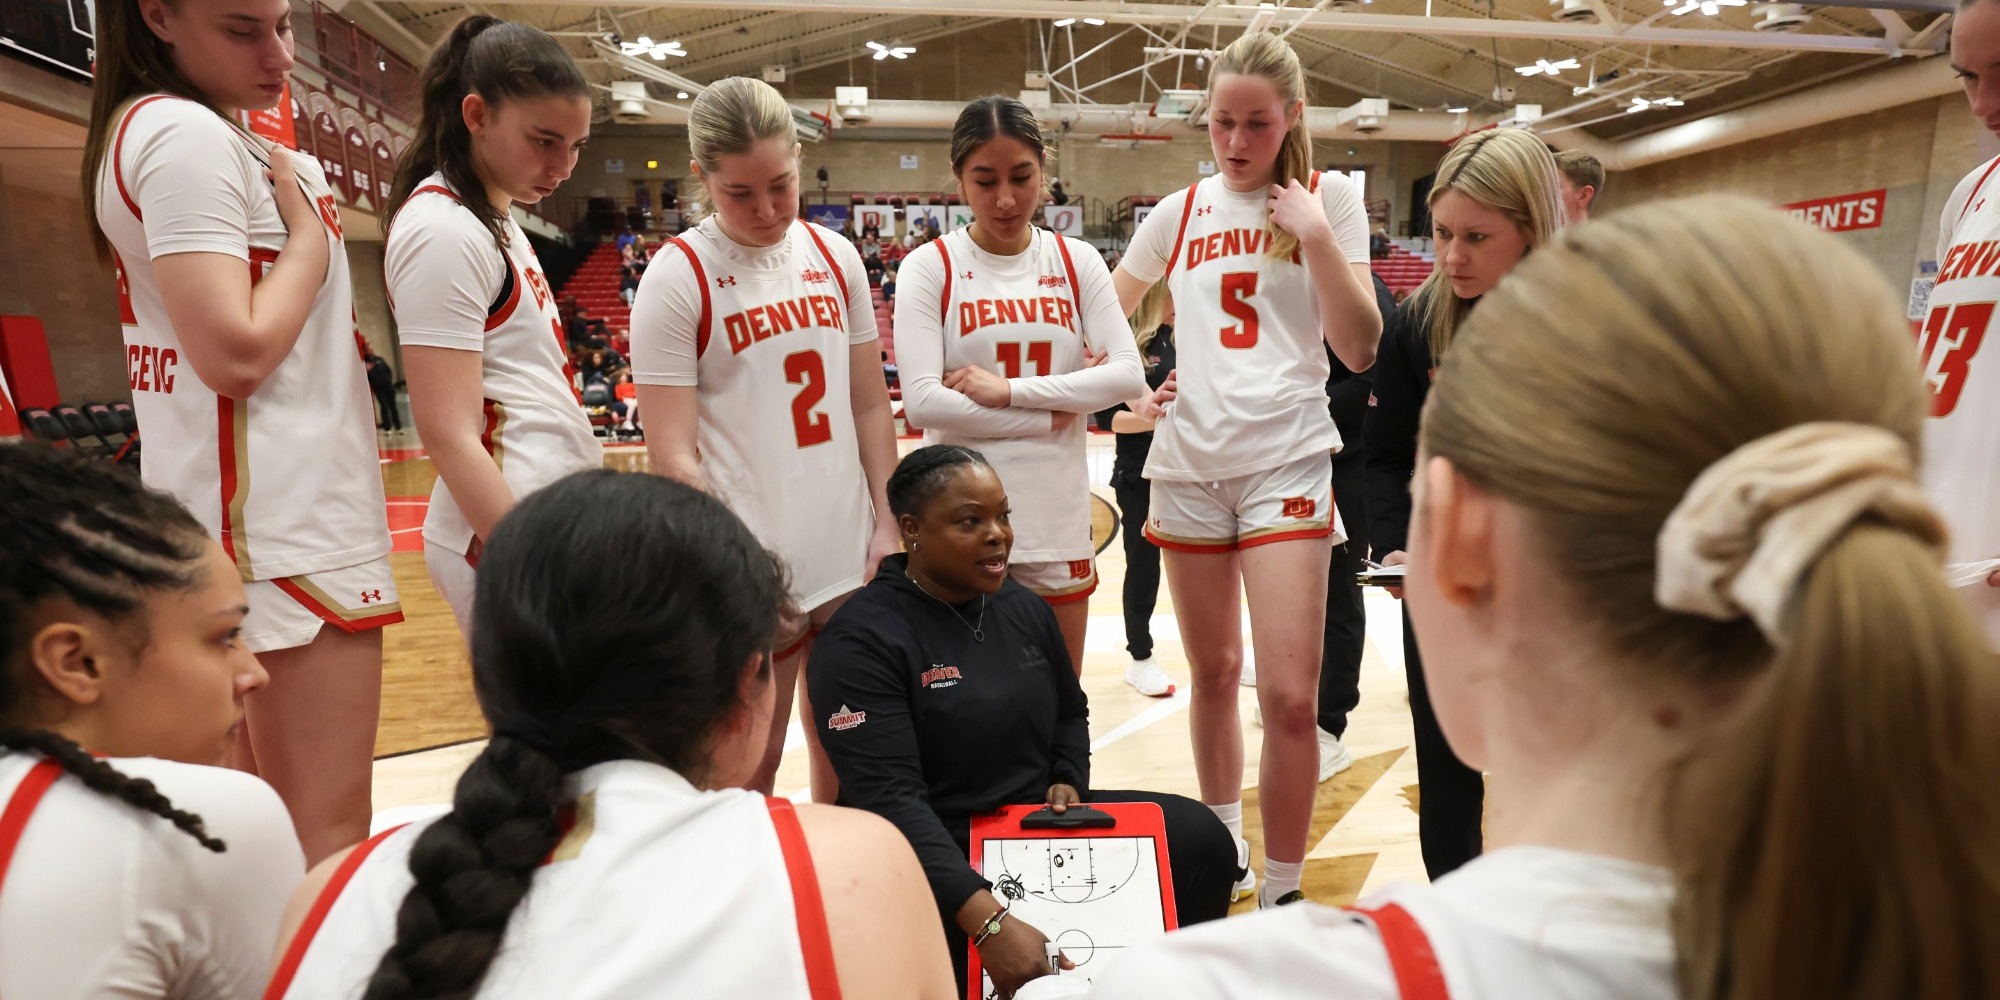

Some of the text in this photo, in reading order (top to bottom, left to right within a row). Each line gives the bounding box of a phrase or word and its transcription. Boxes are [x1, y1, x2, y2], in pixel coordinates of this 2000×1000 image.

[722, 294, 845, 357] DENVER
[959, 296, 1077, 338] DENVER
[1219, 271, 1260, 351] 5
[994, 340, 1053, 379] 11
[1920, 301, 1998, 420] 13
[783, 348, 833, 450] 2
[921, 666, 963, 688] DENVER
[829, 711, 865, 727] SUMMIT
